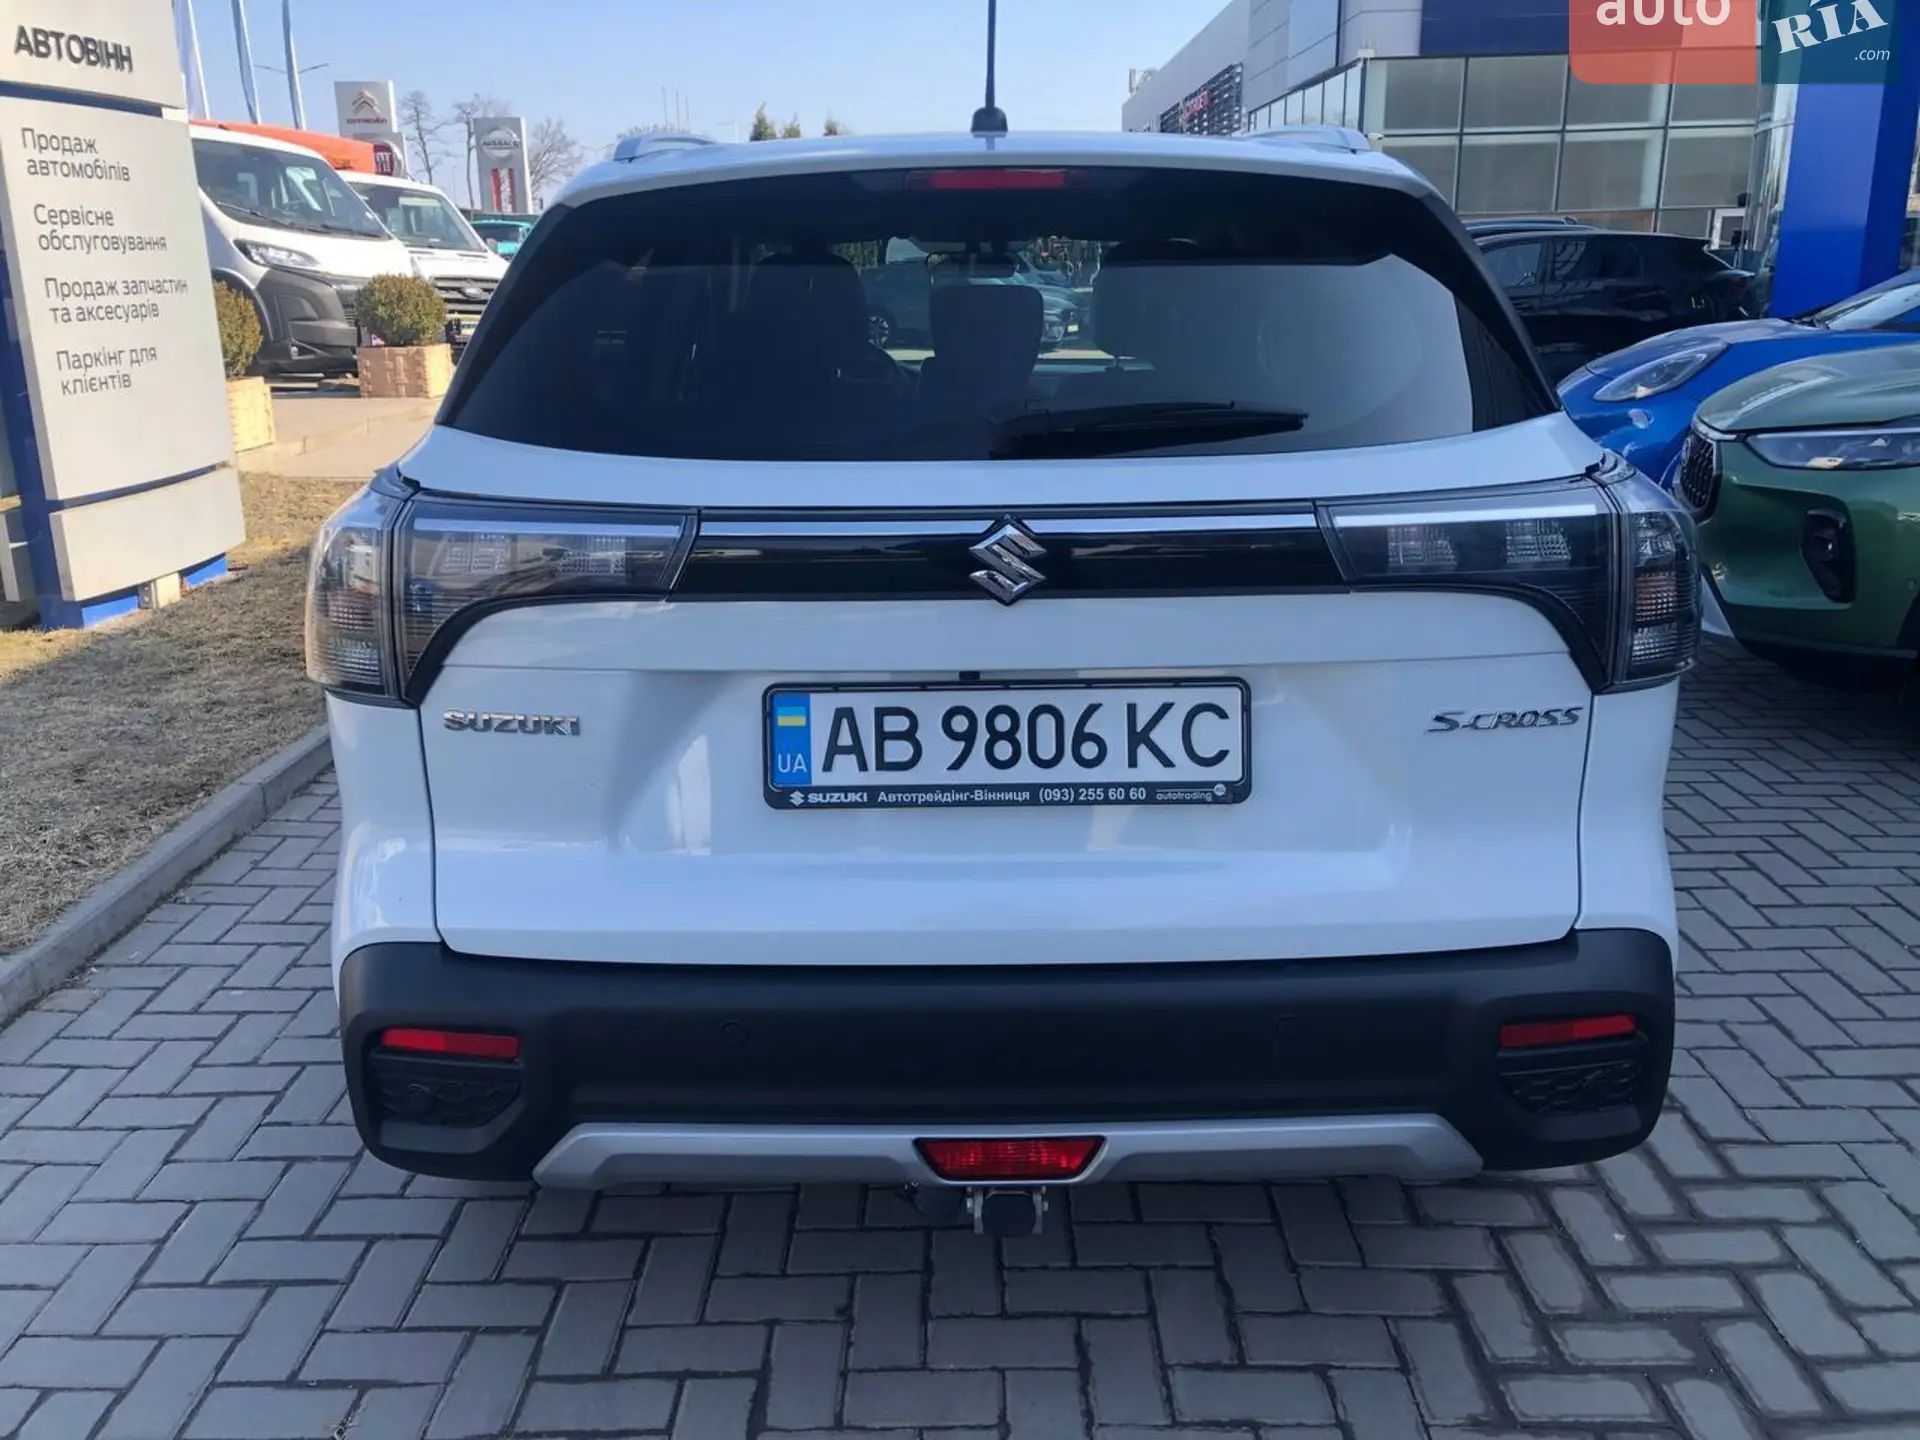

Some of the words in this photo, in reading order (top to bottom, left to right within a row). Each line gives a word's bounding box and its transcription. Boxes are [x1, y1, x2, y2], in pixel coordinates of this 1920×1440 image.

[14, 24, 134, 73] АВТОВІНН
[21, 127, 99, 155] Продаж
[27, 157, 131, 182] автомобілів
[34, 203, 114, 231] Сервісне
[38, 229, 167, 255] обслуговування
[45, 276, 119, 303] Продаж
[122, 279, 187, 295] запчастин
[50, 308, 72, 324] та
[76, 301, 160, 325] аксесуарів
[57, 349, 126, 376] Паркінг
[129, 346, 157, 368] для
[61, 370, 132, 397] клієнтів
[443, 708, 581, 736] SUZUKI
[1427, 706, 1584, 732] S-CROSS
[821, 705, 923, 772] AB
[941, 703, 1107, 772] 9806
[1127, 701, 1230, 769] KC
[777, 753, 808, 773] UA
[807, 791, 868, 804] SUZUKI
[877, 788, 1030, 805] Автотрейдінг-Вінниця
[1038, 788, 1075, 803] (093)
[1078, 787, 1105, 801] 255
[1108, 787, 1125, 801] 60
[1129, 787, 1146, 800] 60
[1156, 791, 1212, 802] autotrading
